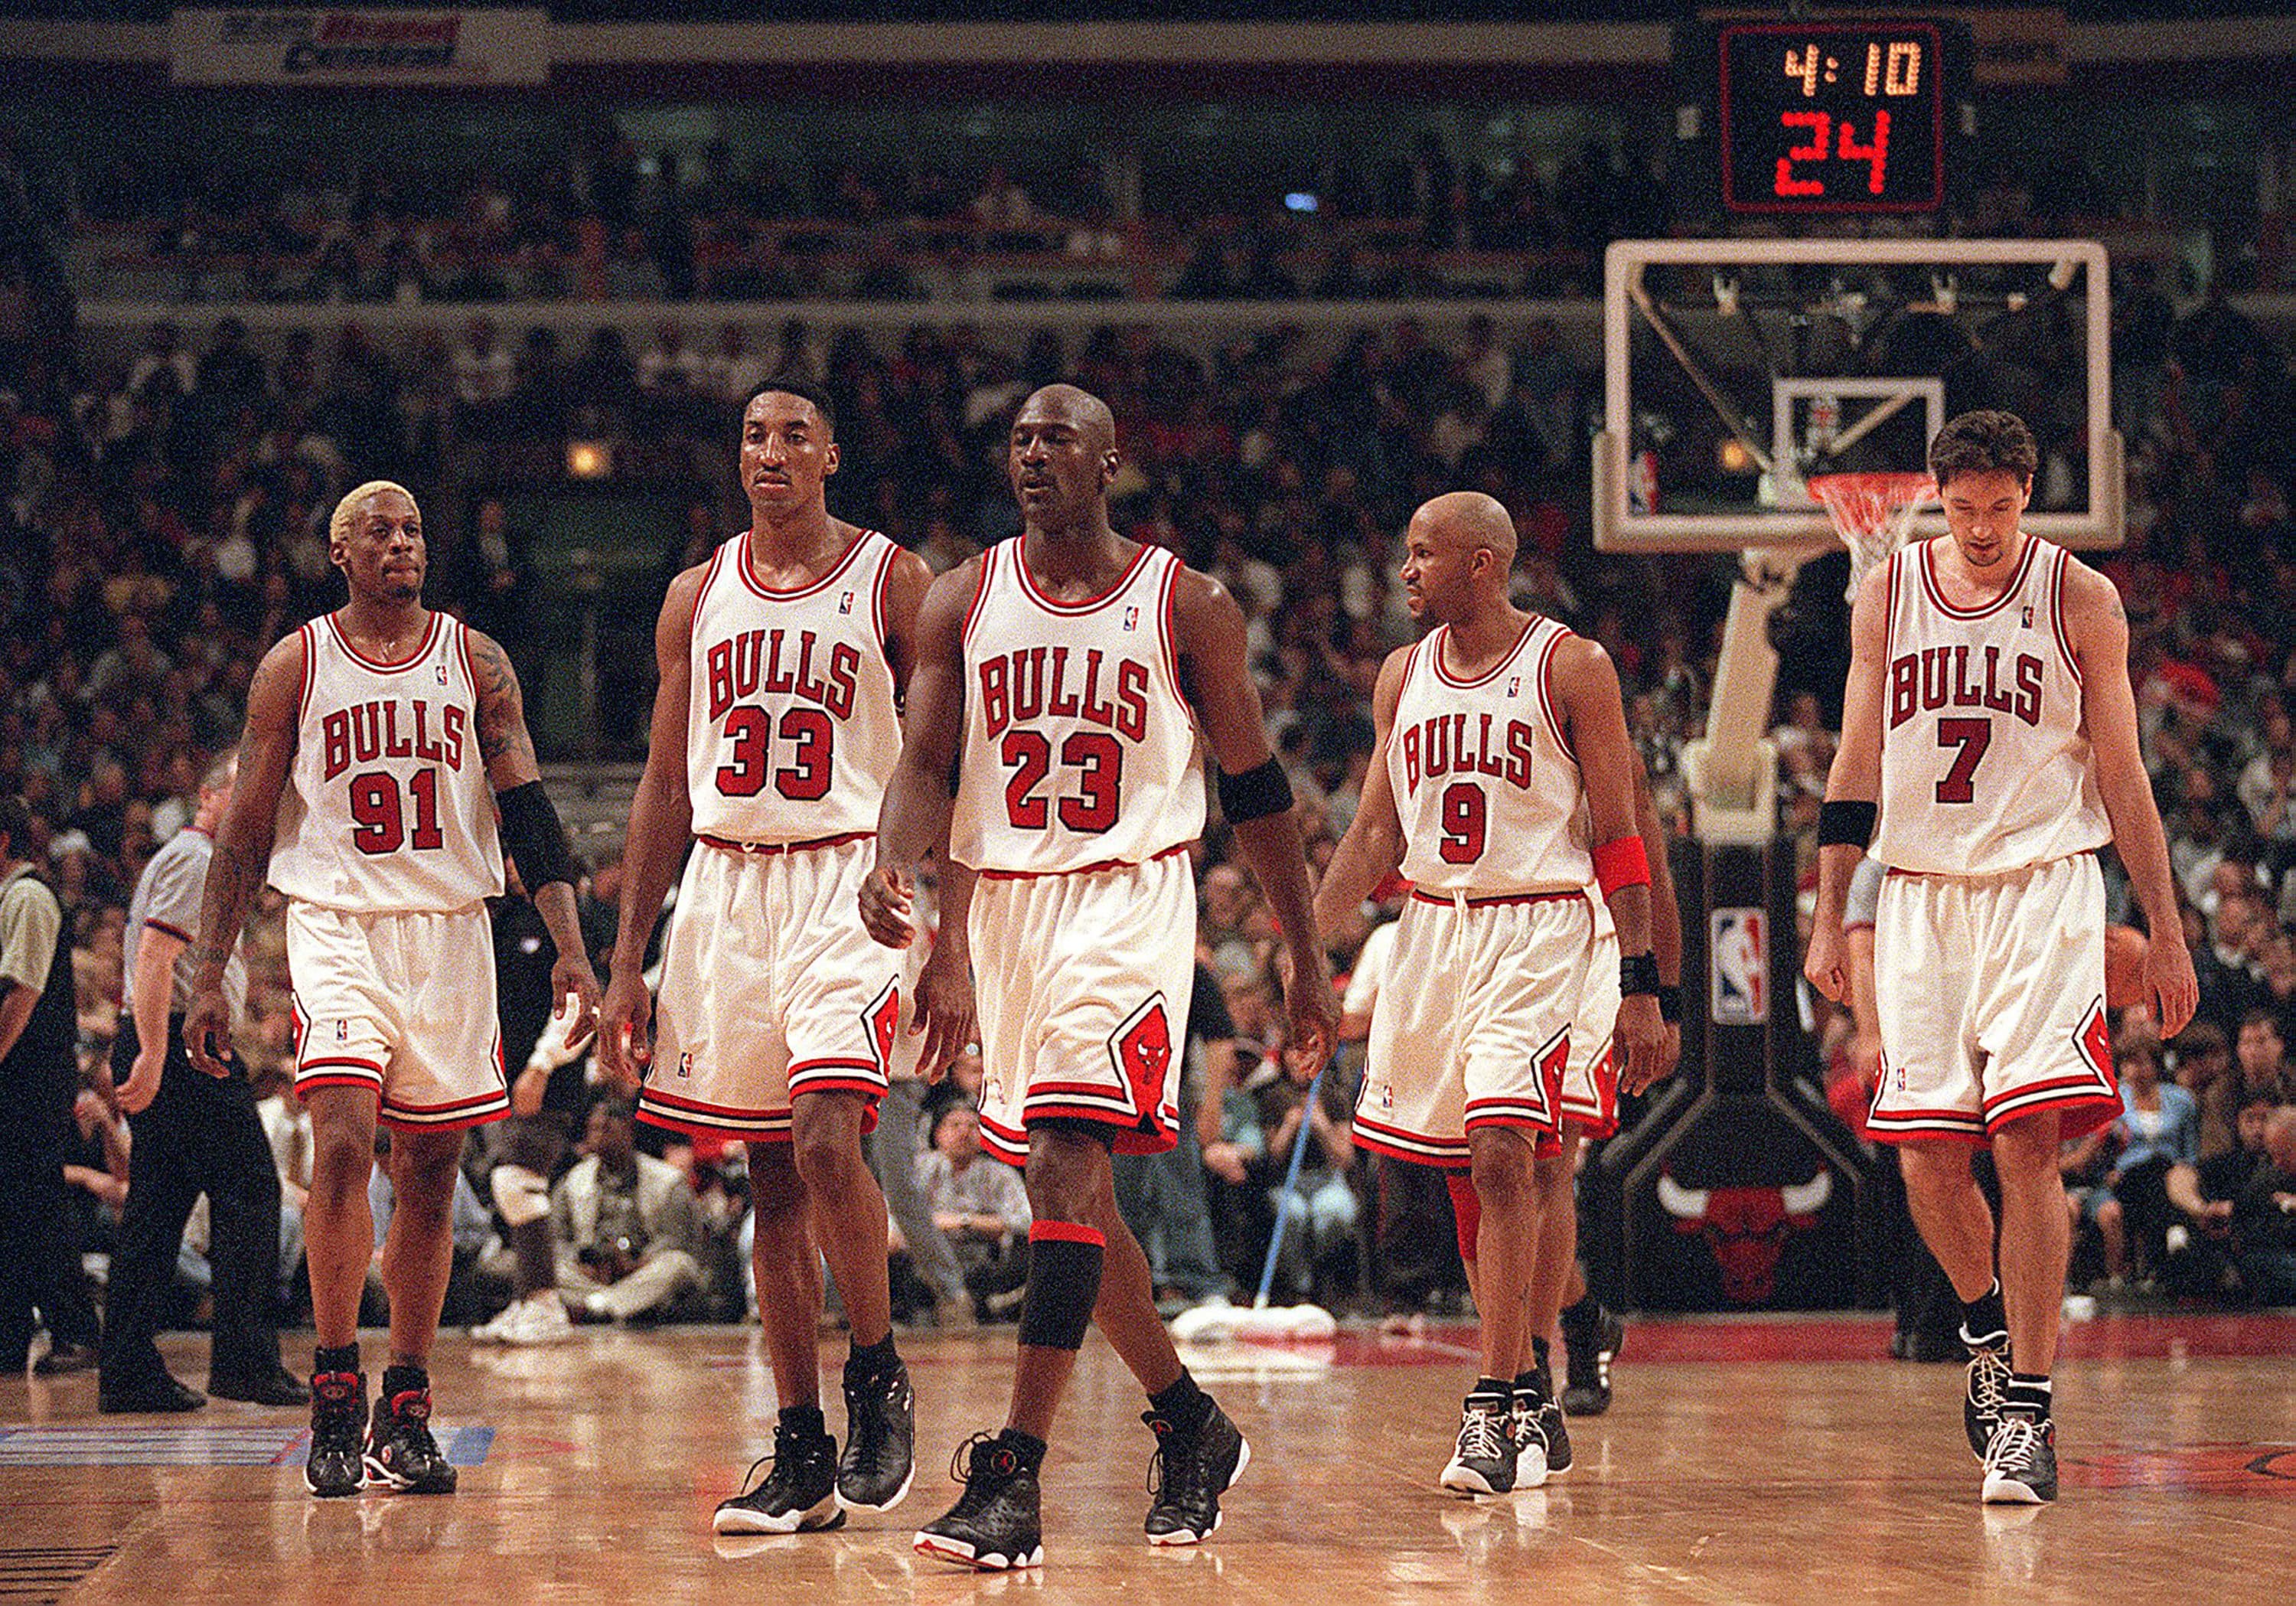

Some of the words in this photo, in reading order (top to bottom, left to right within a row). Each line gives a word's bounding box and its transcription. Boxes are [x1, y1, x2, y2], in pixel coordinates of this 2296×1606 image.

[1784, 43, 1921, 97] 4:10
[1774, 110, 1892, 197] 24
[707, 630, 861, 723] BULLS
[979, 647, 1149, 741] BULLS
[1890, 646, 2043, 730] BULLS
[322, 700, 465, 782] BULLS
[715, 704, 834, 801] 33
[1001, 729, 1124, 834] 23
[1403, 713, 1533, 801] BULLS
[1936, 717, 1992, 804] 7
[348, 768, 443, 855] 91
[1439, 782, 1486, 865] 9
